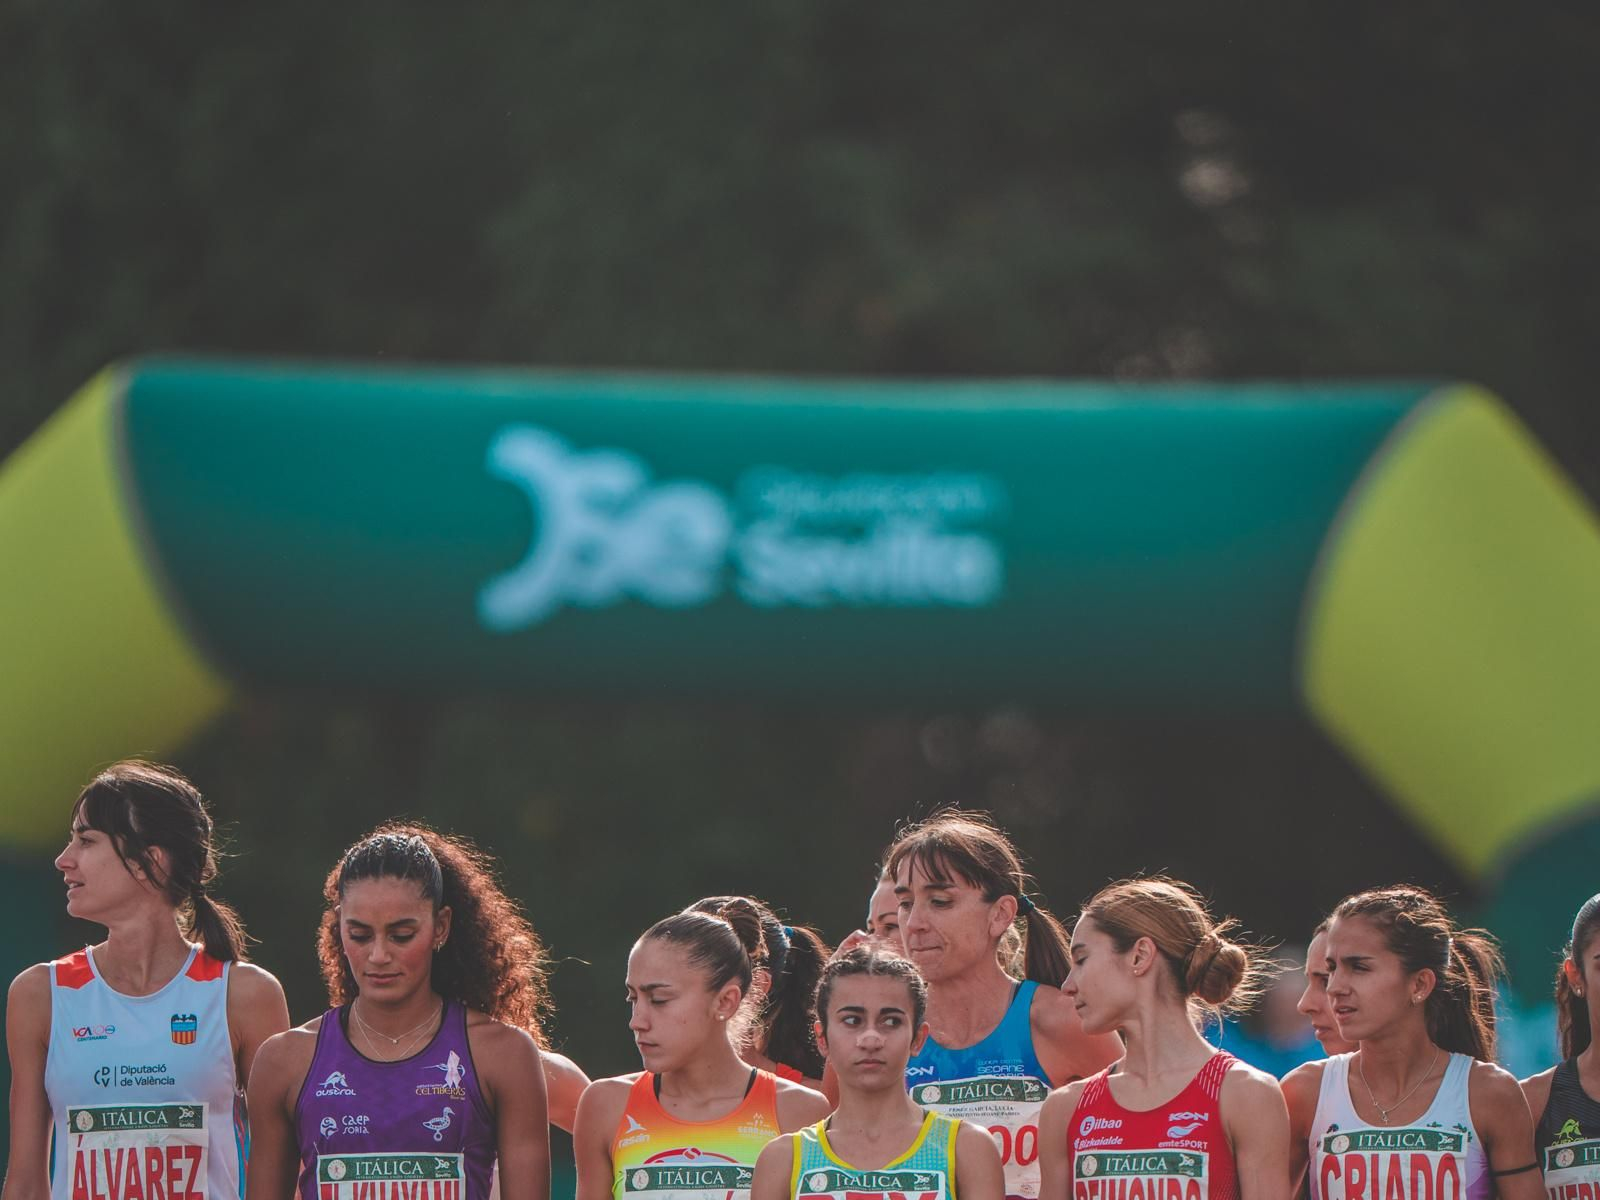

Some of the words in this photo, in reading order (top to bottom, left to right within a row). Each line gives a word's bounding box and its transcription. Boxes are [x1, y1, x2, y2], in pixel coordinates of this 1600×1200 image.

[120, 1063, 167, 1076] Diputació
[120, 1077, 133, 1087] de
[134, 1076, 175, 1087] València
[950, 1083, 1014, 1101] ITÁLICA
[102, 1108, 168, 1127] ITÁLICA
[1080, 1116, 1123, 1137] Bilbao
[1158, 1139, 1208, 1150] emteSPORT
[1358, 1131, 1426, 1147] ITÁLICA
[355, 1158, 424, 1176] ITÁLICA
[1105, 1154, 1168, 1171] ITÁLICA
[657, 1167, 725, 1185] ITÁLICA
